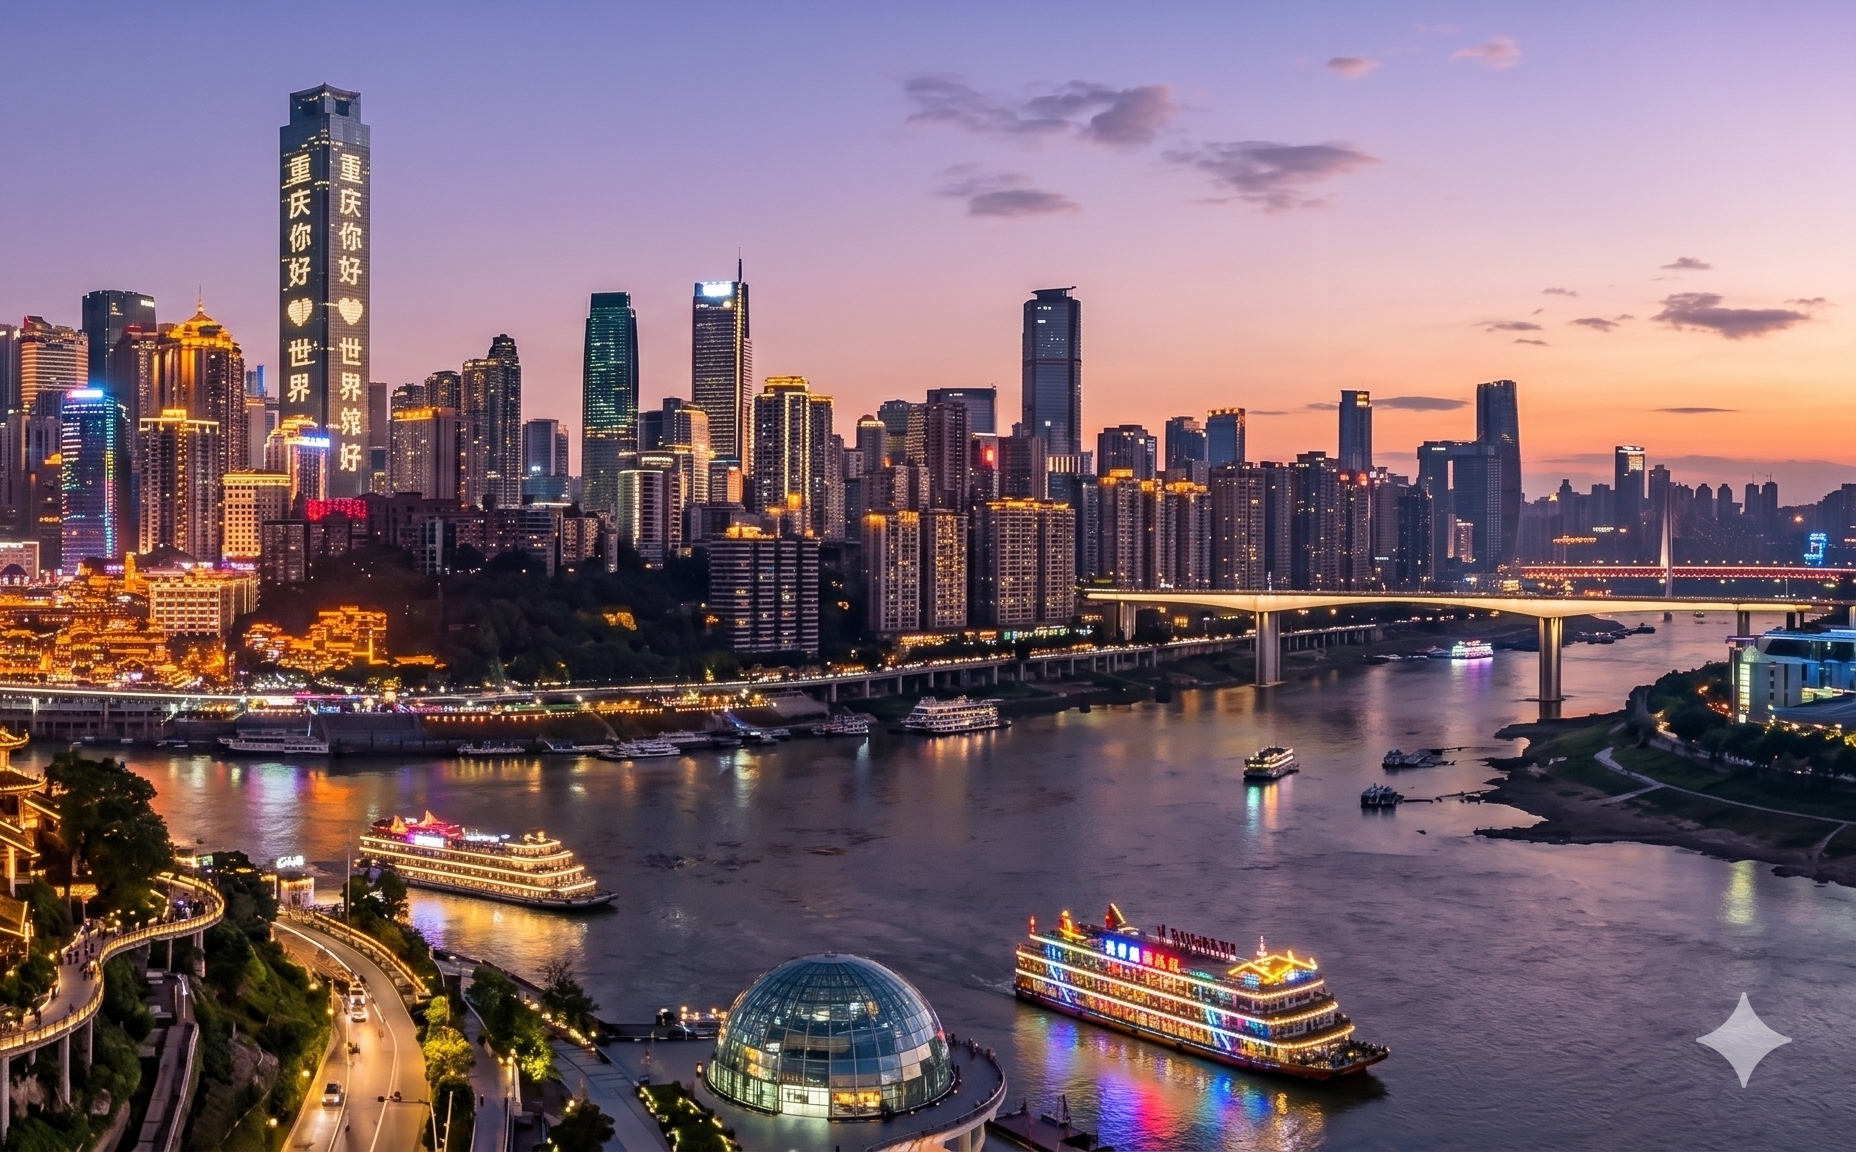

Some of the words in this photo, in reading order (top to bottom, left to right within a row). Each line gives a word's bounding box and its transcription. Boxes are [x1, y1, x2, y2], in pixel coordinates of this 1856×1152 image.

[288, 153, 312, 288] 重庆你好
[339, 153, 363, 286] 重庆你好
[287, 337, 314, 403] 世界
